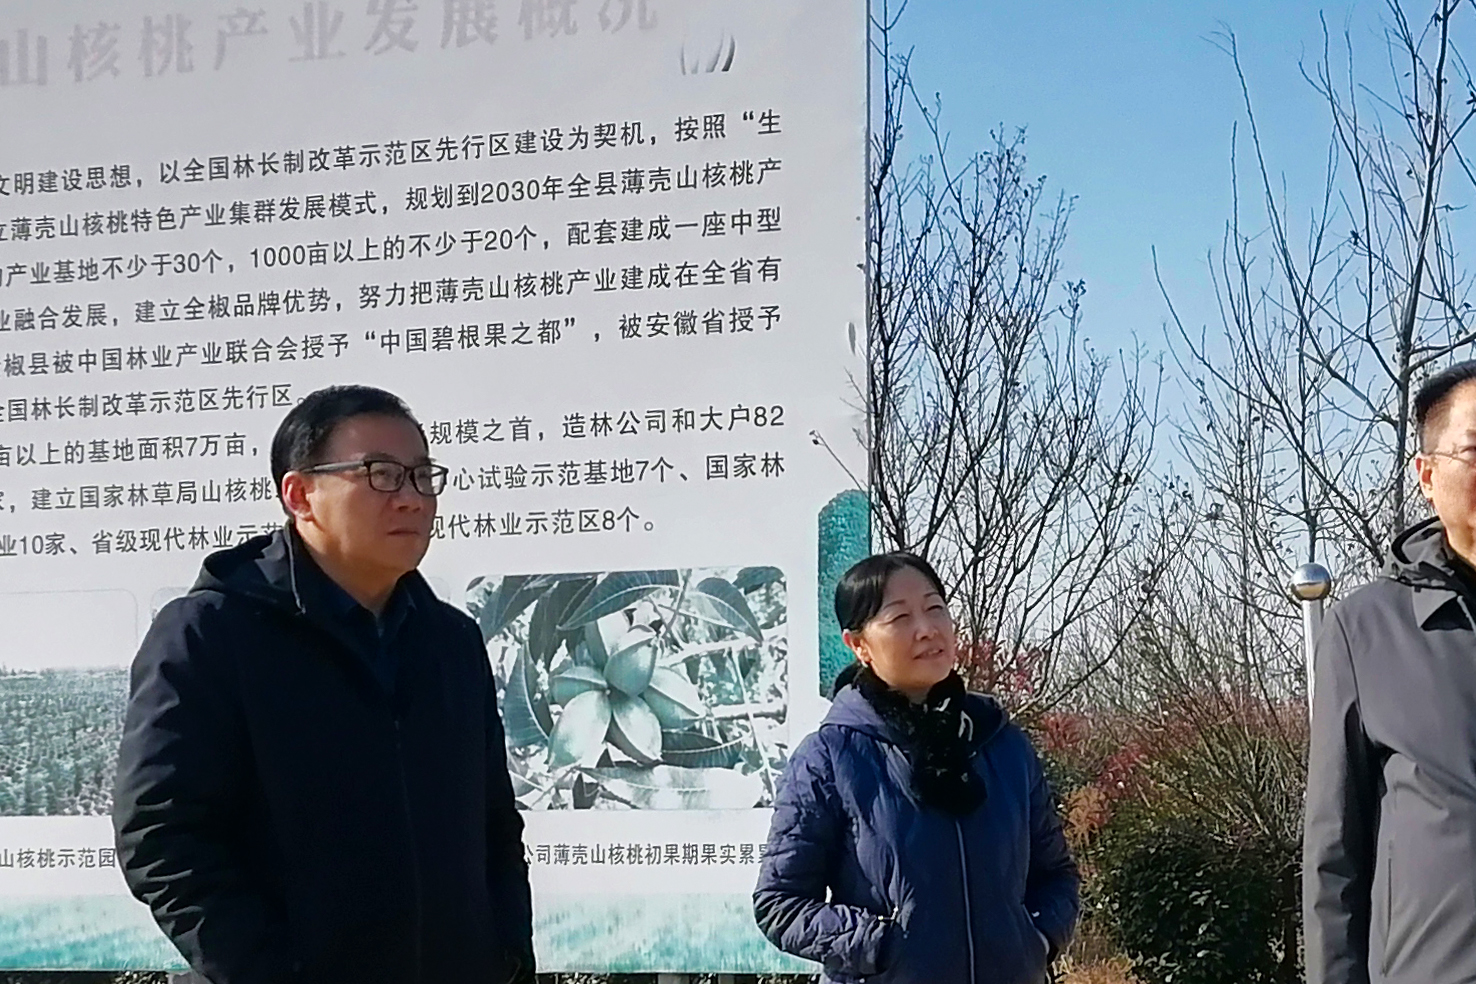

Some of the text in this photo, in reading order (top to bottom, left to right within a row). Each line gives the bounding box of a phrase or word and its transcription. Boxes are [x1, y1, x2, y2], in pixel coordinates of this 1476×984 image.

[0, 207, 782, 287] 产业基地不少于30个，1000亩以上的不少于20个，配套建成一座中型
[0, 305, 782, 378] 椒县被中国林业产业联合会授予“中国碧根果之都”，被安徽省授予
[0, 384, 306, 423] 国林长制改革示范区先行区。
[420, 405, 784, 446] 规模之首，造林公司和大户82
[0, 476, 281, 513] ，建立国家林草局山核桃
[0, 848, 116, 868] 山核桃示范园
